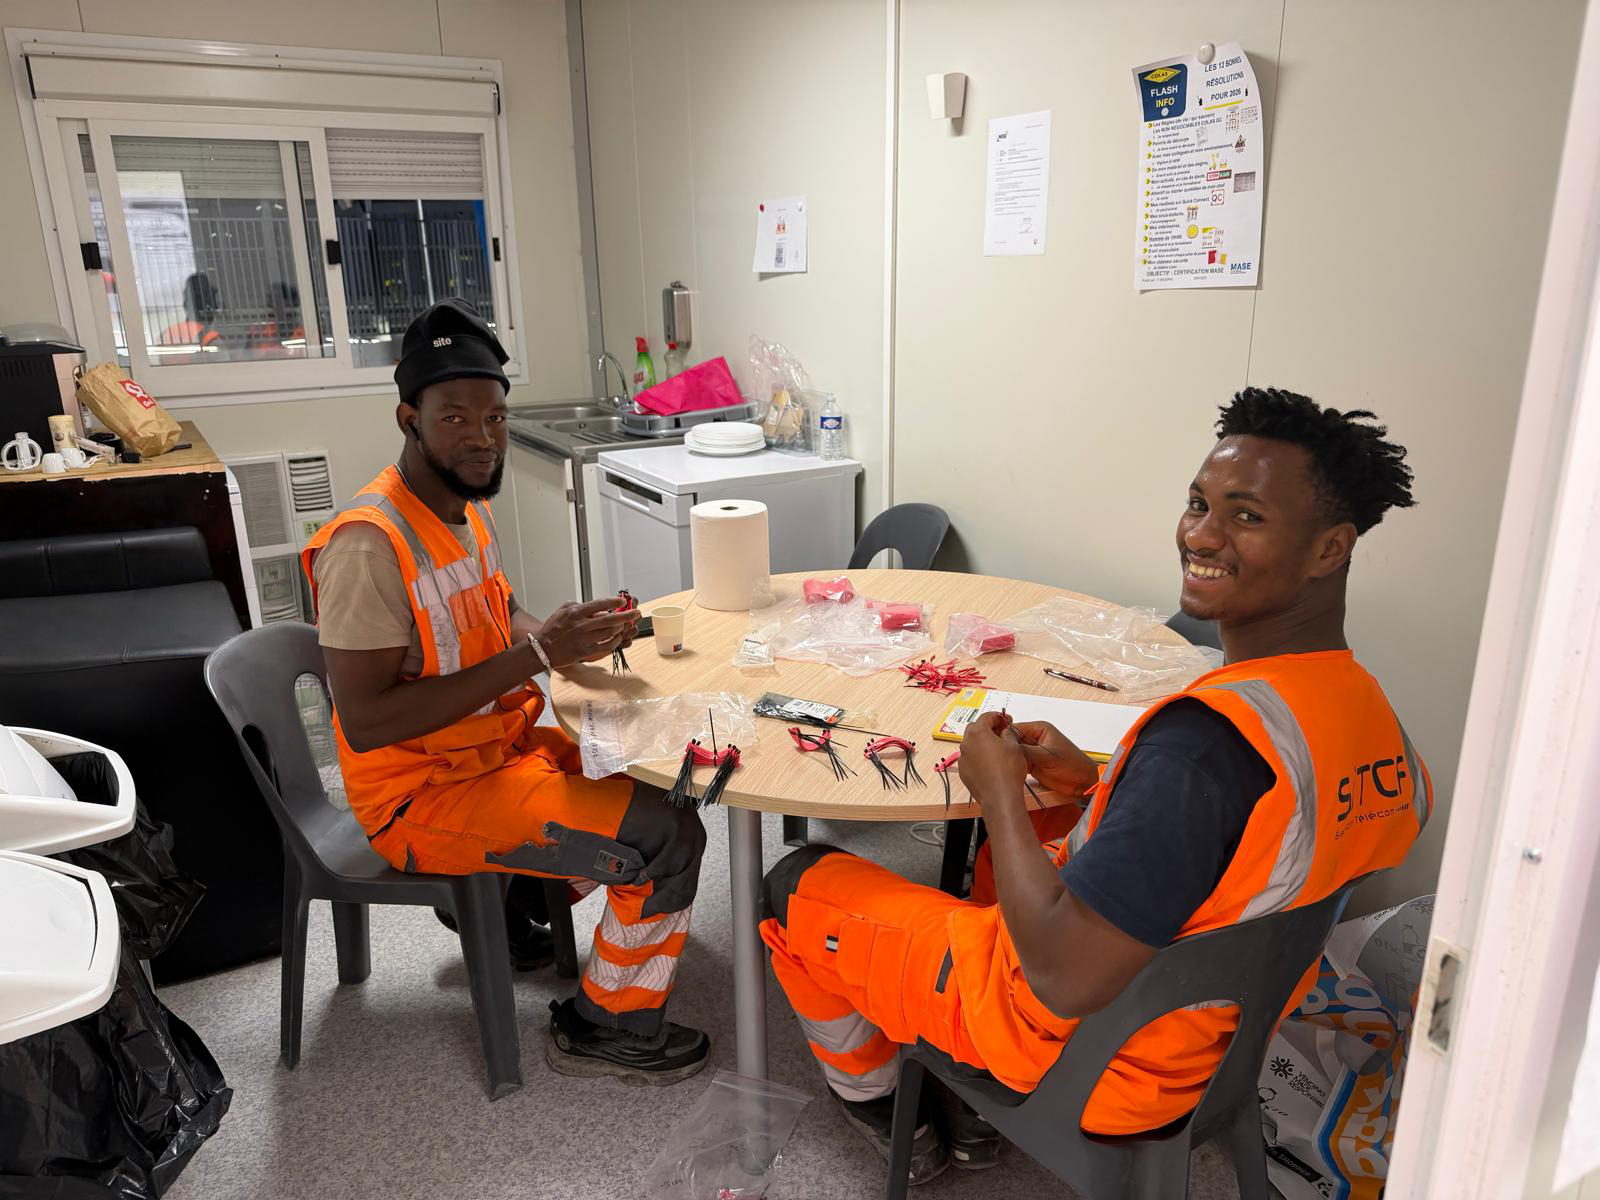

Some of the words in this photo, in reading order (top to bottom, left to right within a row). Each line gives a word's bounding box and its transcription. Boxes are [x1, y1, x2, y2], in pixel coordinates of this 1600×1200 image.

[1205, 63, 1217, 72] LES
[1226, 56, 1242, 68] BONNES
[1206, 71, 1244, 87] RÉSOLUTIONS
[1150, 85, 1178, 97] FLASH
[1210, 91, 1228, 101] POUR
[1230, 88, 1241, 96] 2026
[1156, 98, 1174, 108] INFO
[1171, 121, 1200, 130] NEGOCIABLES
[1211, 194, 1223, 203] QC
[433, 337, 452, 348] site
[1293, 1076, 1312, 1092] MADE
[1299, 1072, 1327, 1098] VENDING
